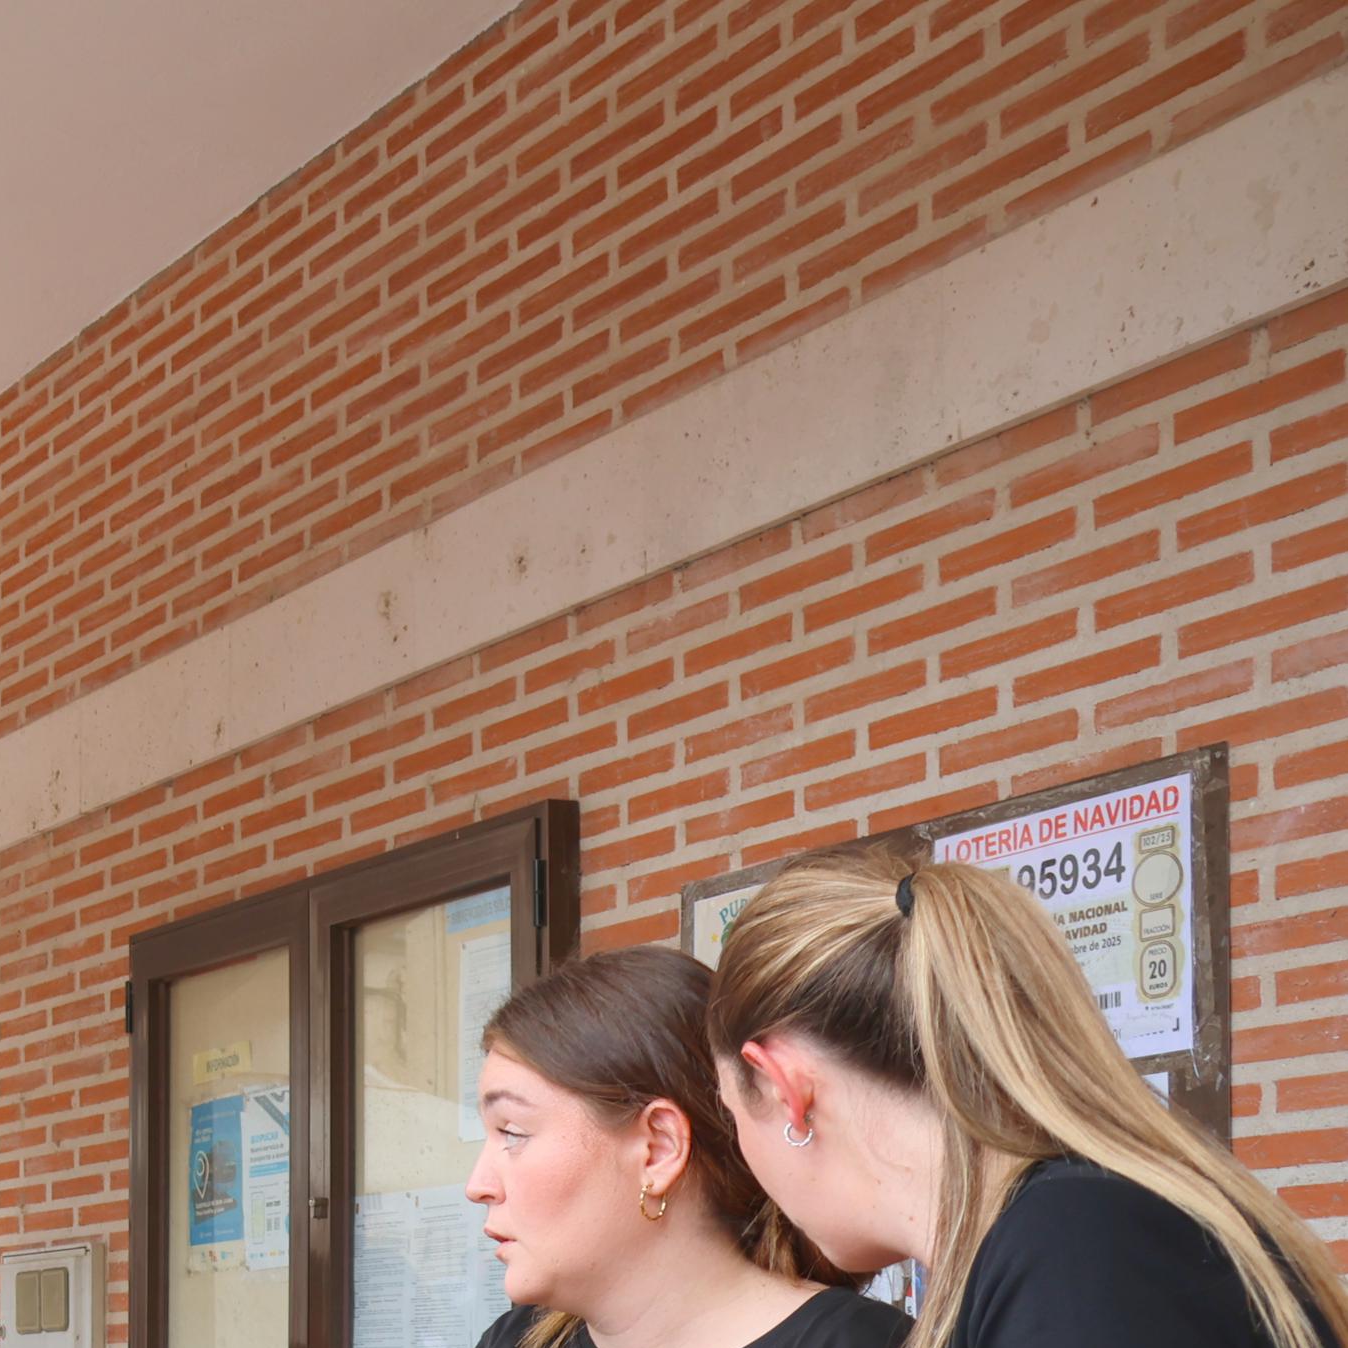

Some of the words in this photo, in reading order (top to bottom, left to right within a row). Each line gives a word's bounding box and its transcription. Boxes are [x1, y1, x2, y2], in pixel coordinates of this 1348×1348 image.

[945, 822, 1033, 863] LOTERÍA
[1038, 813, 1067, 843] DE
[1073, 785, 1180, 835] NAVIDAD
[1016, 841, 1126, 900] 95934
[1068, 901, 1128, 923] NACIONAL
[1065, 922, 1107, 940] AVIDAD
[1072, 943, 1087, 954] bre
[1089, 941, 1099, 951] de
[1101, 936, 1122, 948] 2025
[1149, 959, 1167, 979] 20
